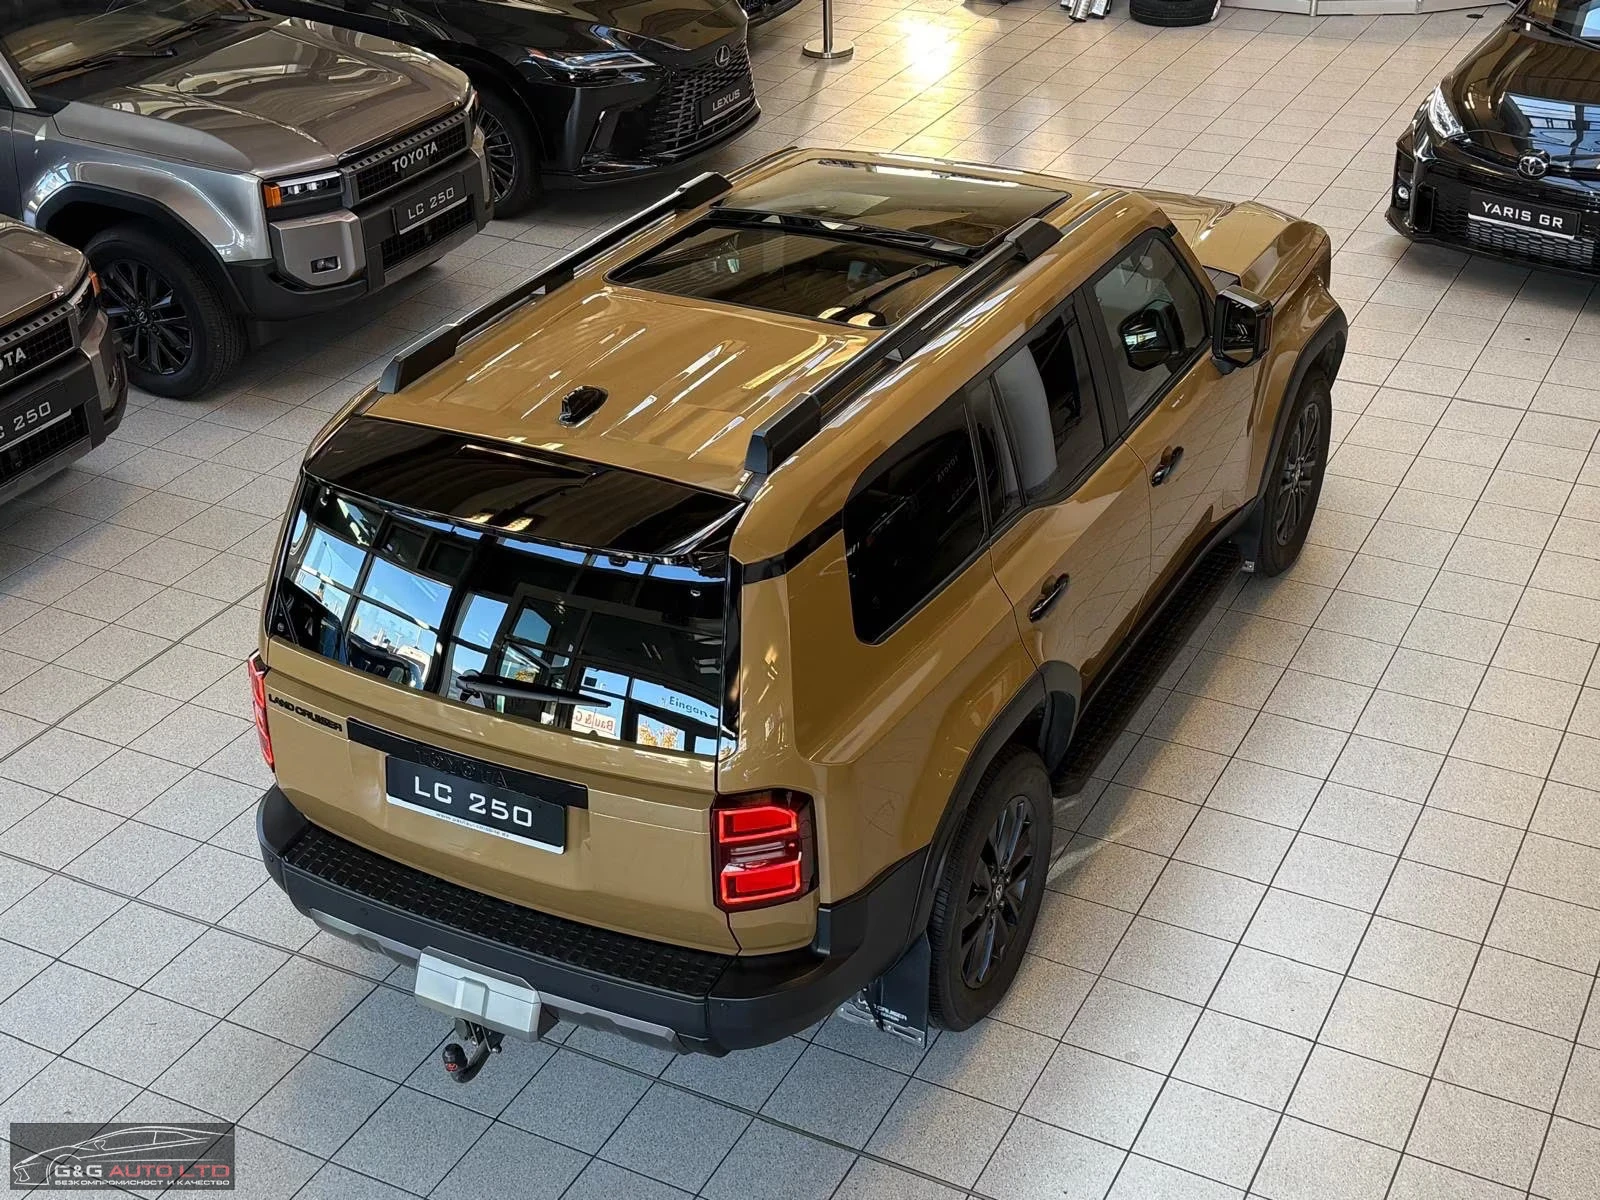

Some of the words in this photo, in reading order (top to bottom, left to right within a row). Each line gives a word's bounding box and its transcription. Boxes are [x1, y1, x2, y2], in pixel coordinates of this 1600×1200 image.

[712, 88, 741, 111] LEXUS
[392, 141, 438, 172] TOYOTA
[408, 203, 424, 219] LC
[429, 187, 455, 209] 250
[1482, 201, 1532, 222] YARIS
[1539, 214, 1563, 229] GR
[13, 401, 51, 431] 250
[268, 693, 294, 712] LAND
[295, 706, 343, 732] CRUISER
[414, 775, 452, 805] LC
[468, 792, 533, 828] 250
